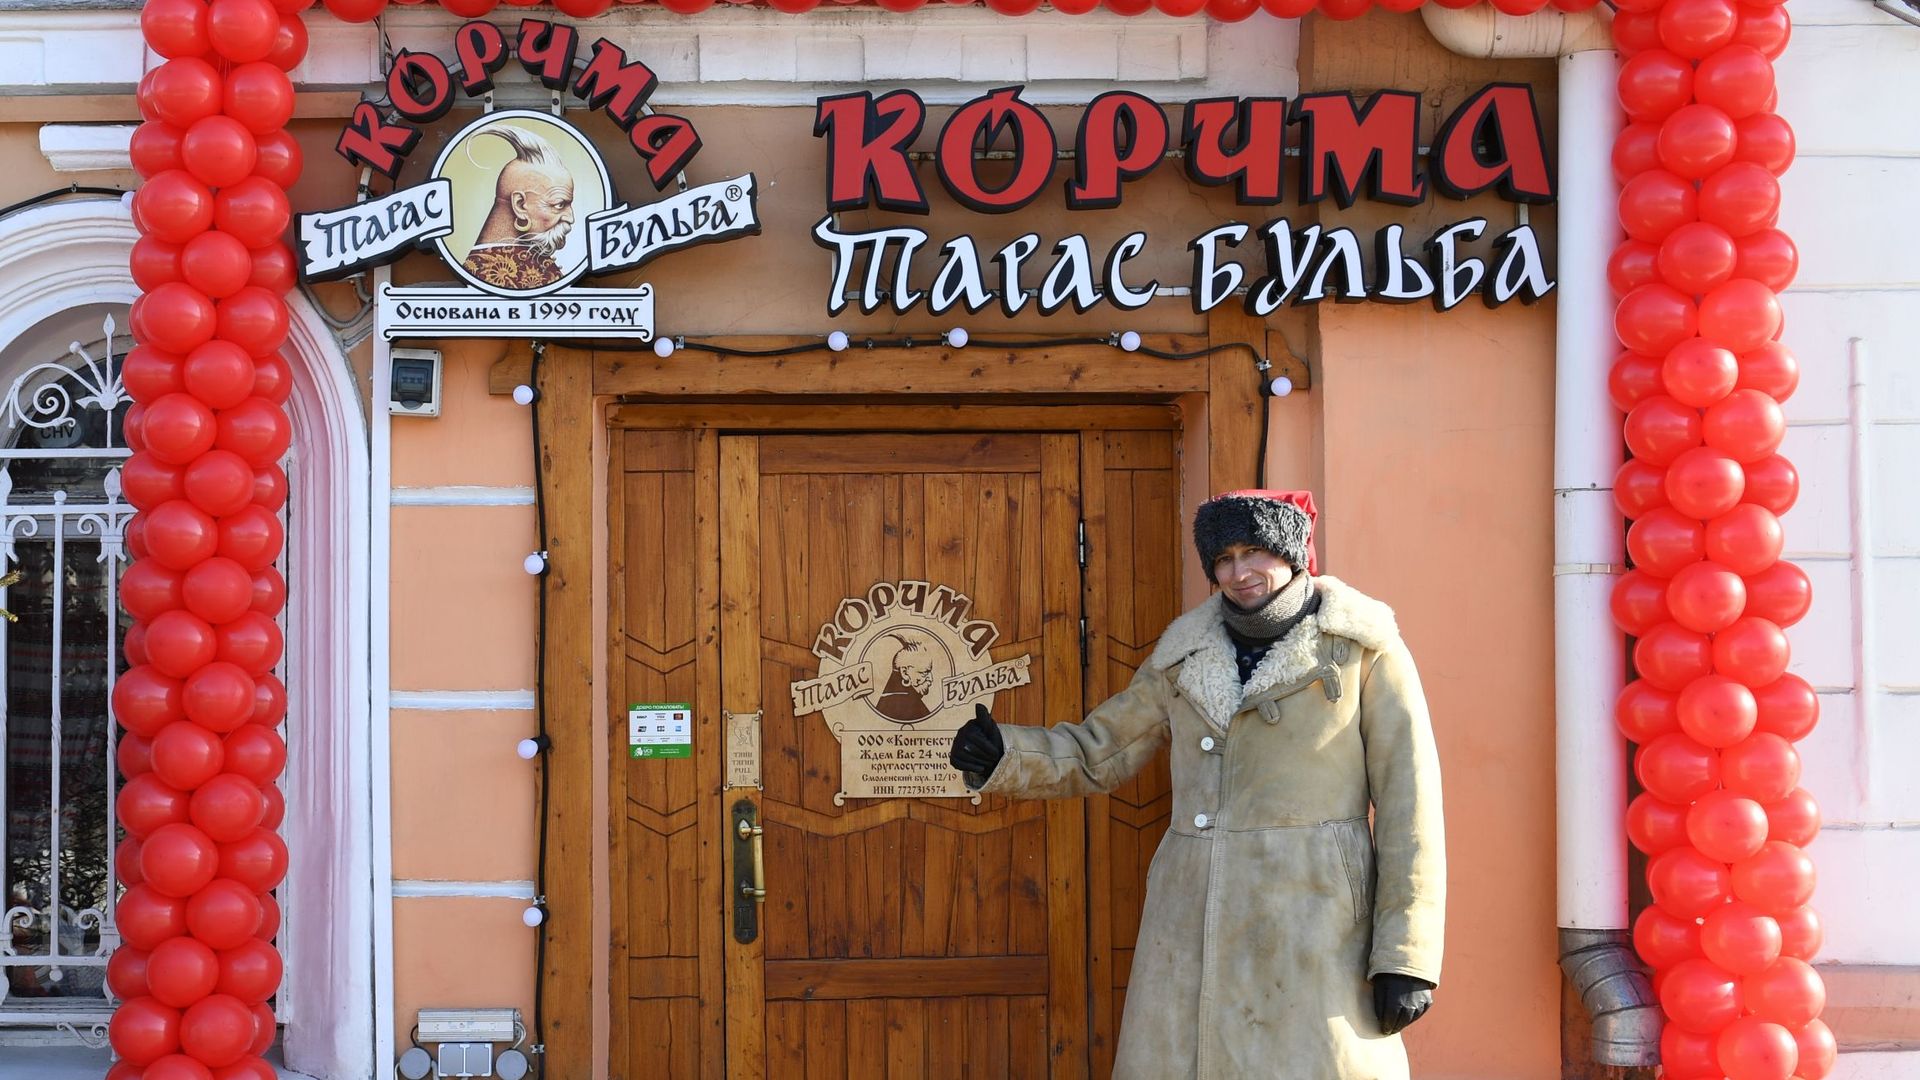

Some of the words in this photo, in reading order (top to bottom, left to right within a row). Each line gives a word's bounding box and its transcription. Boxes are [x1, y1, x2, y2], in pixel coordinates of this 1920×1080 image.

[336, 18, 702, 191] КОРЧМА
[814, 83, 1557, 213] КОРЧМА
[396, 302, 501, 322] Основана
[508, 306, 520, 321] в
[528, 302, 582, 321] 1999
[588, 305, 640, 326] году
[815, 583, 998, 661] КОРЧМА
[857, 735, 884, 746] ООО
[896, 749, 916, 760] Вас
[918, 749, 933, 760] 24
[871, 762, 948, 773] круглосуточно
[861, 773, 912, 782] Смоленский
[933, 773, 958, 782] 12/19
[873, 786, 894, 795] ИНН
[897, 785, 947, 795] 7727315574
